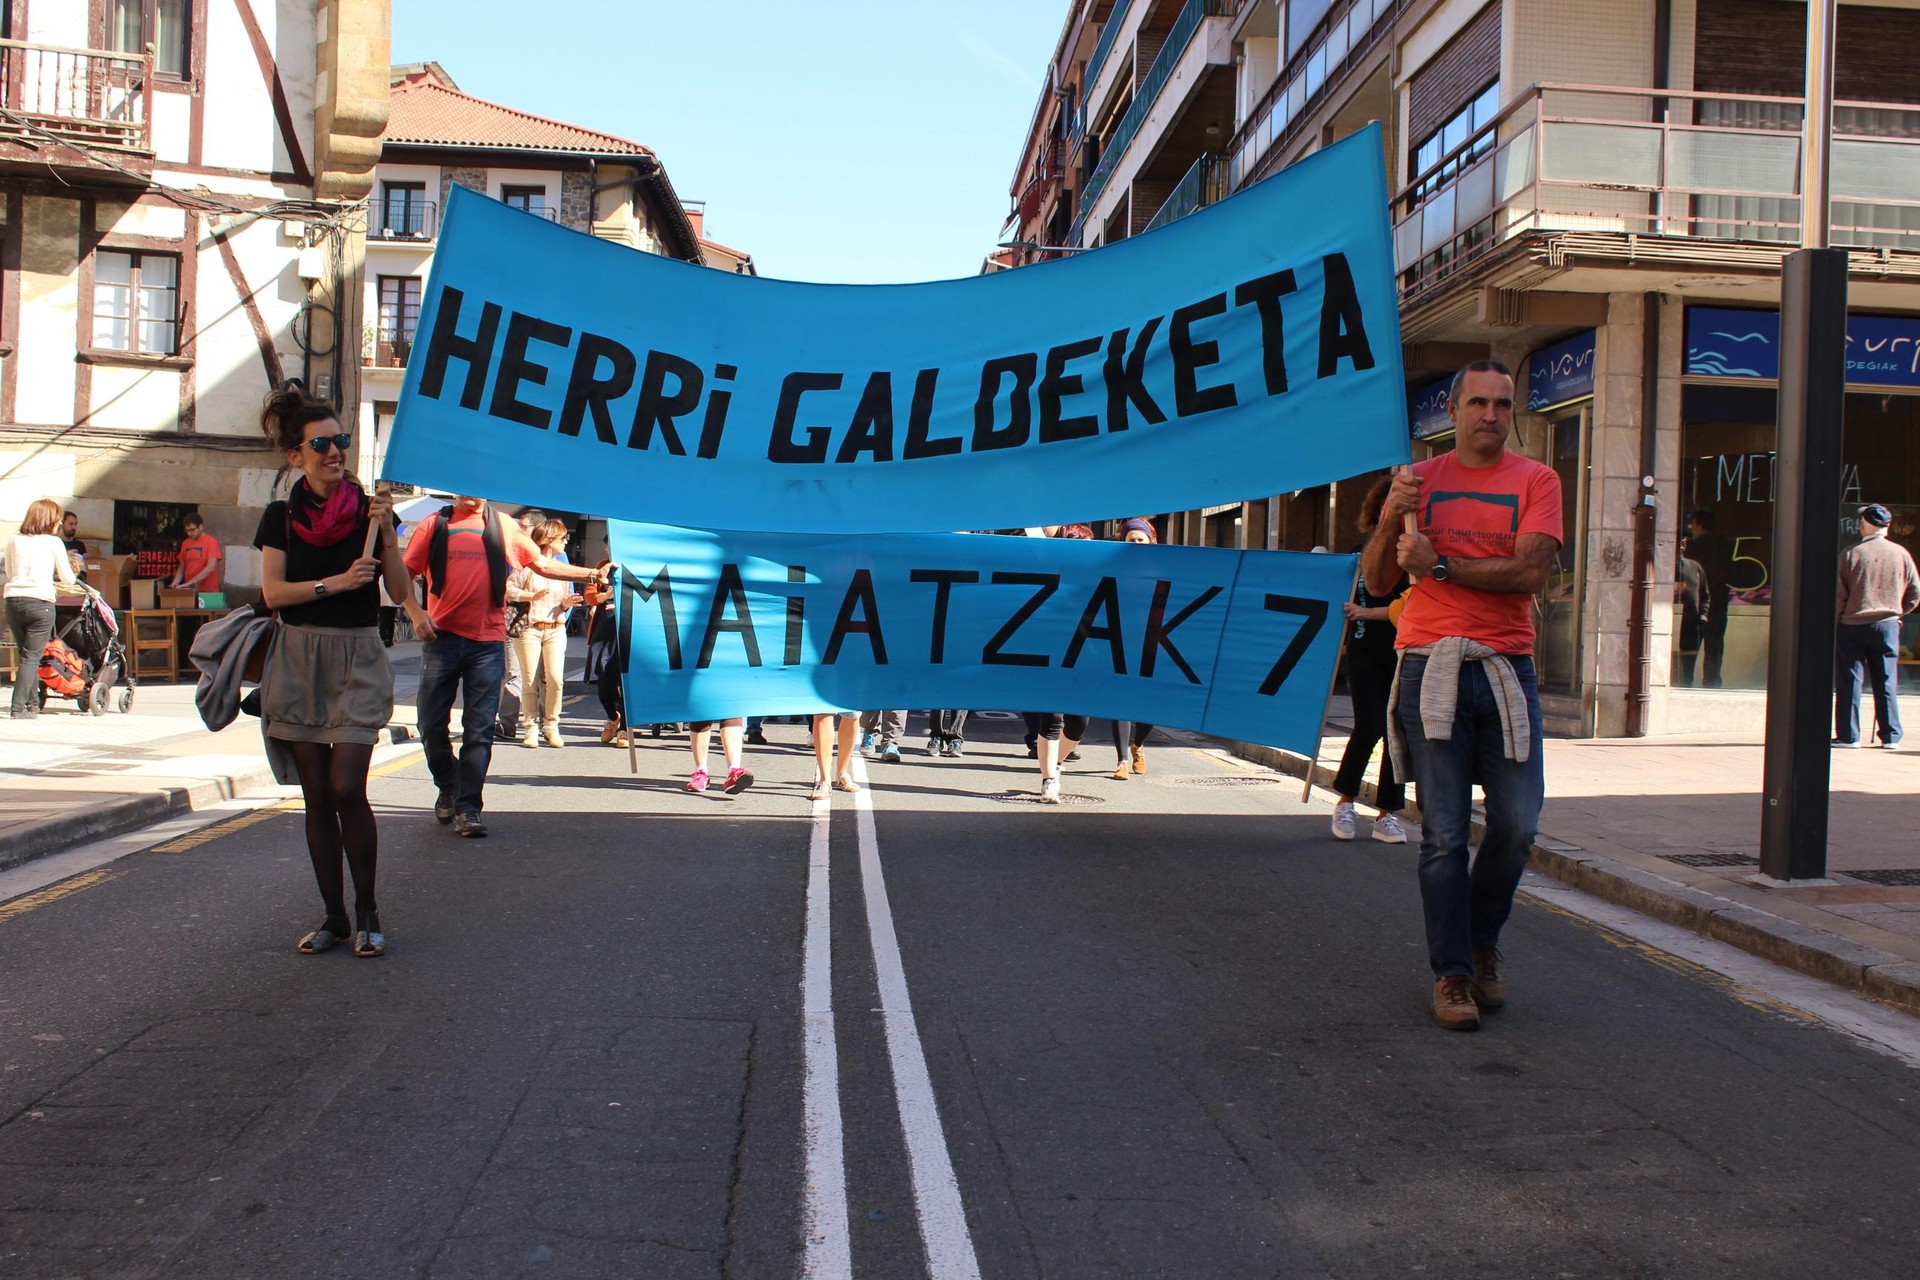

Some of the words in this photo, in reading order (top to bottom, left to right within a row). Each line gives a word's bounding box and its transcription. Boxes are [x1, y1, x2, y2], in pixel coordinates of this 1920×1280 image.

[767, 252, 1376, 464] GALDEKETA
[1725, 536, 1768, 592] 5
[1257, 592, 1329, 697] 7
